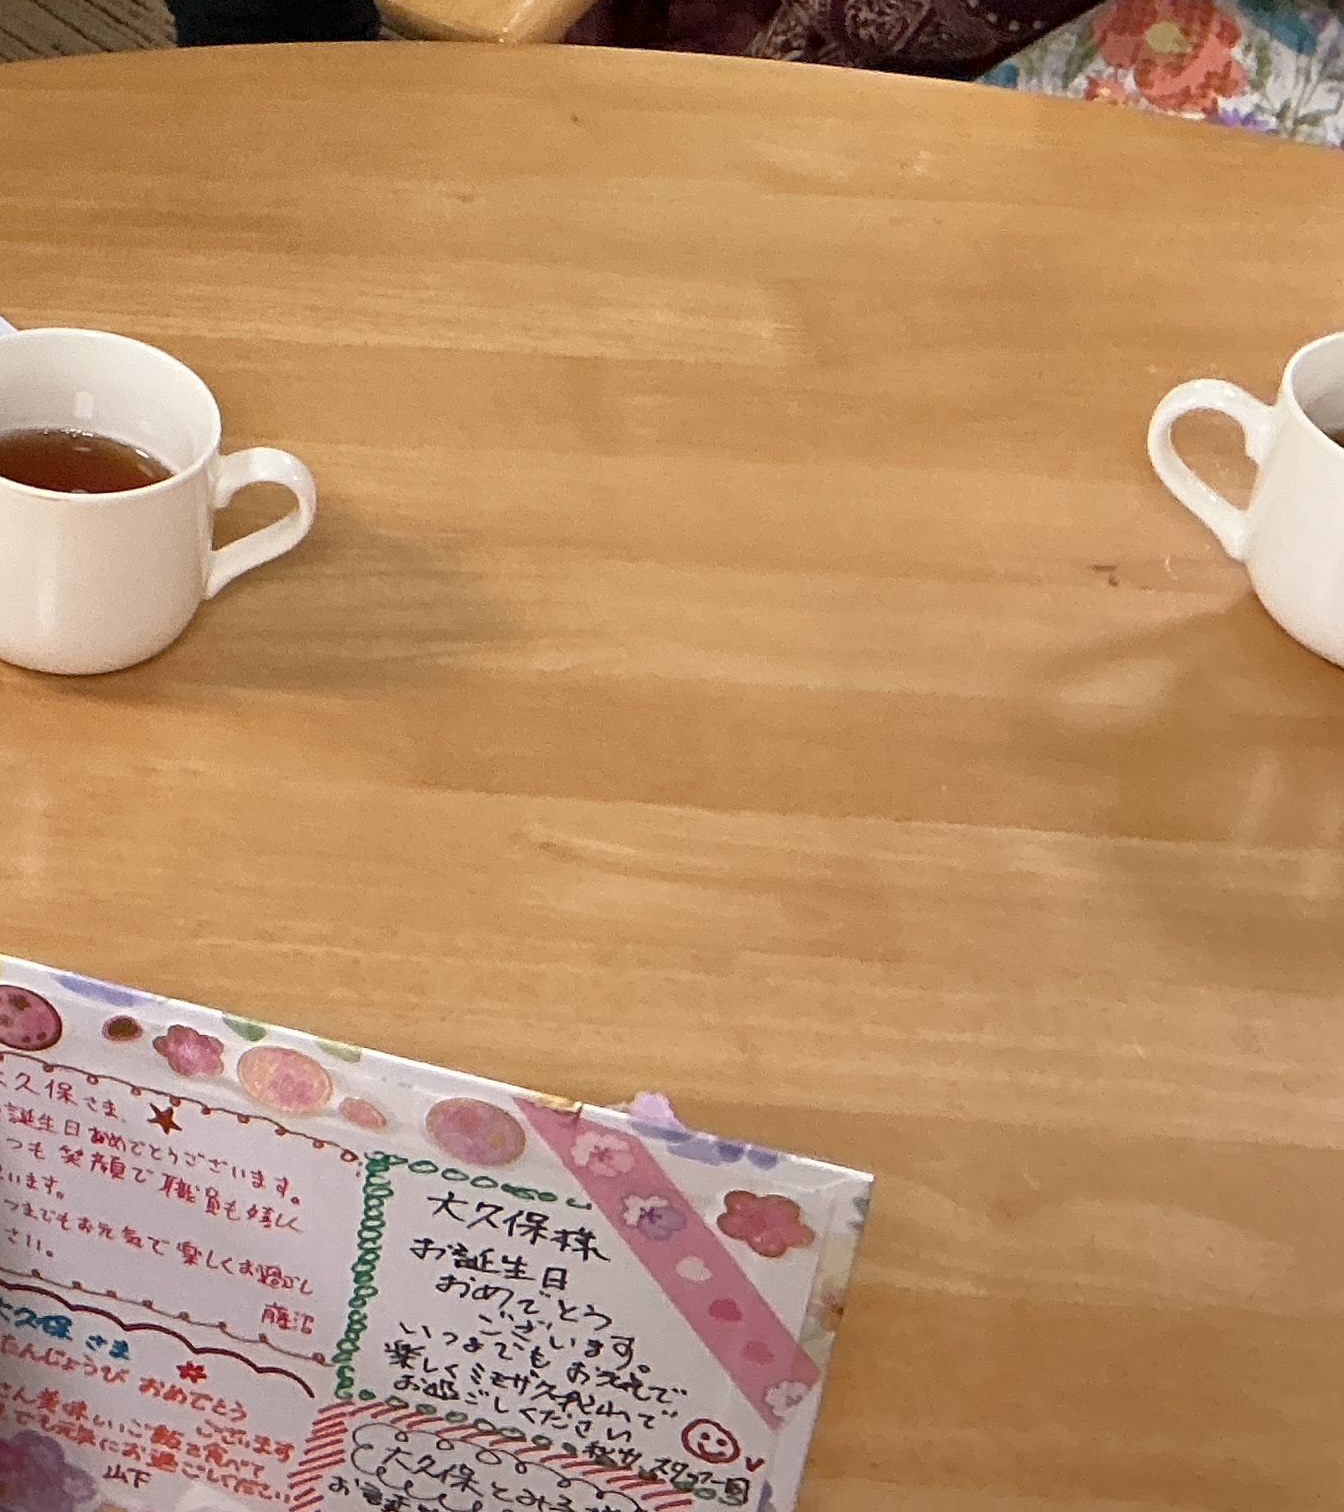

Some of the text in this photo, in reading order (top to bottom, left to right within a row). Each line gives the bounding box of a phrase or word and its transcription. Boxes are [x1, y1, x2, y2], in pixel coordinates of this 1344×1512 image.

[426, 1190, 611, 1263] 大久保様
[409, 1237, 568, 1291] お誕生日
[435, 1273, 614, 1331] おめでとう
[102, 1463, 152, 1489] 山下
